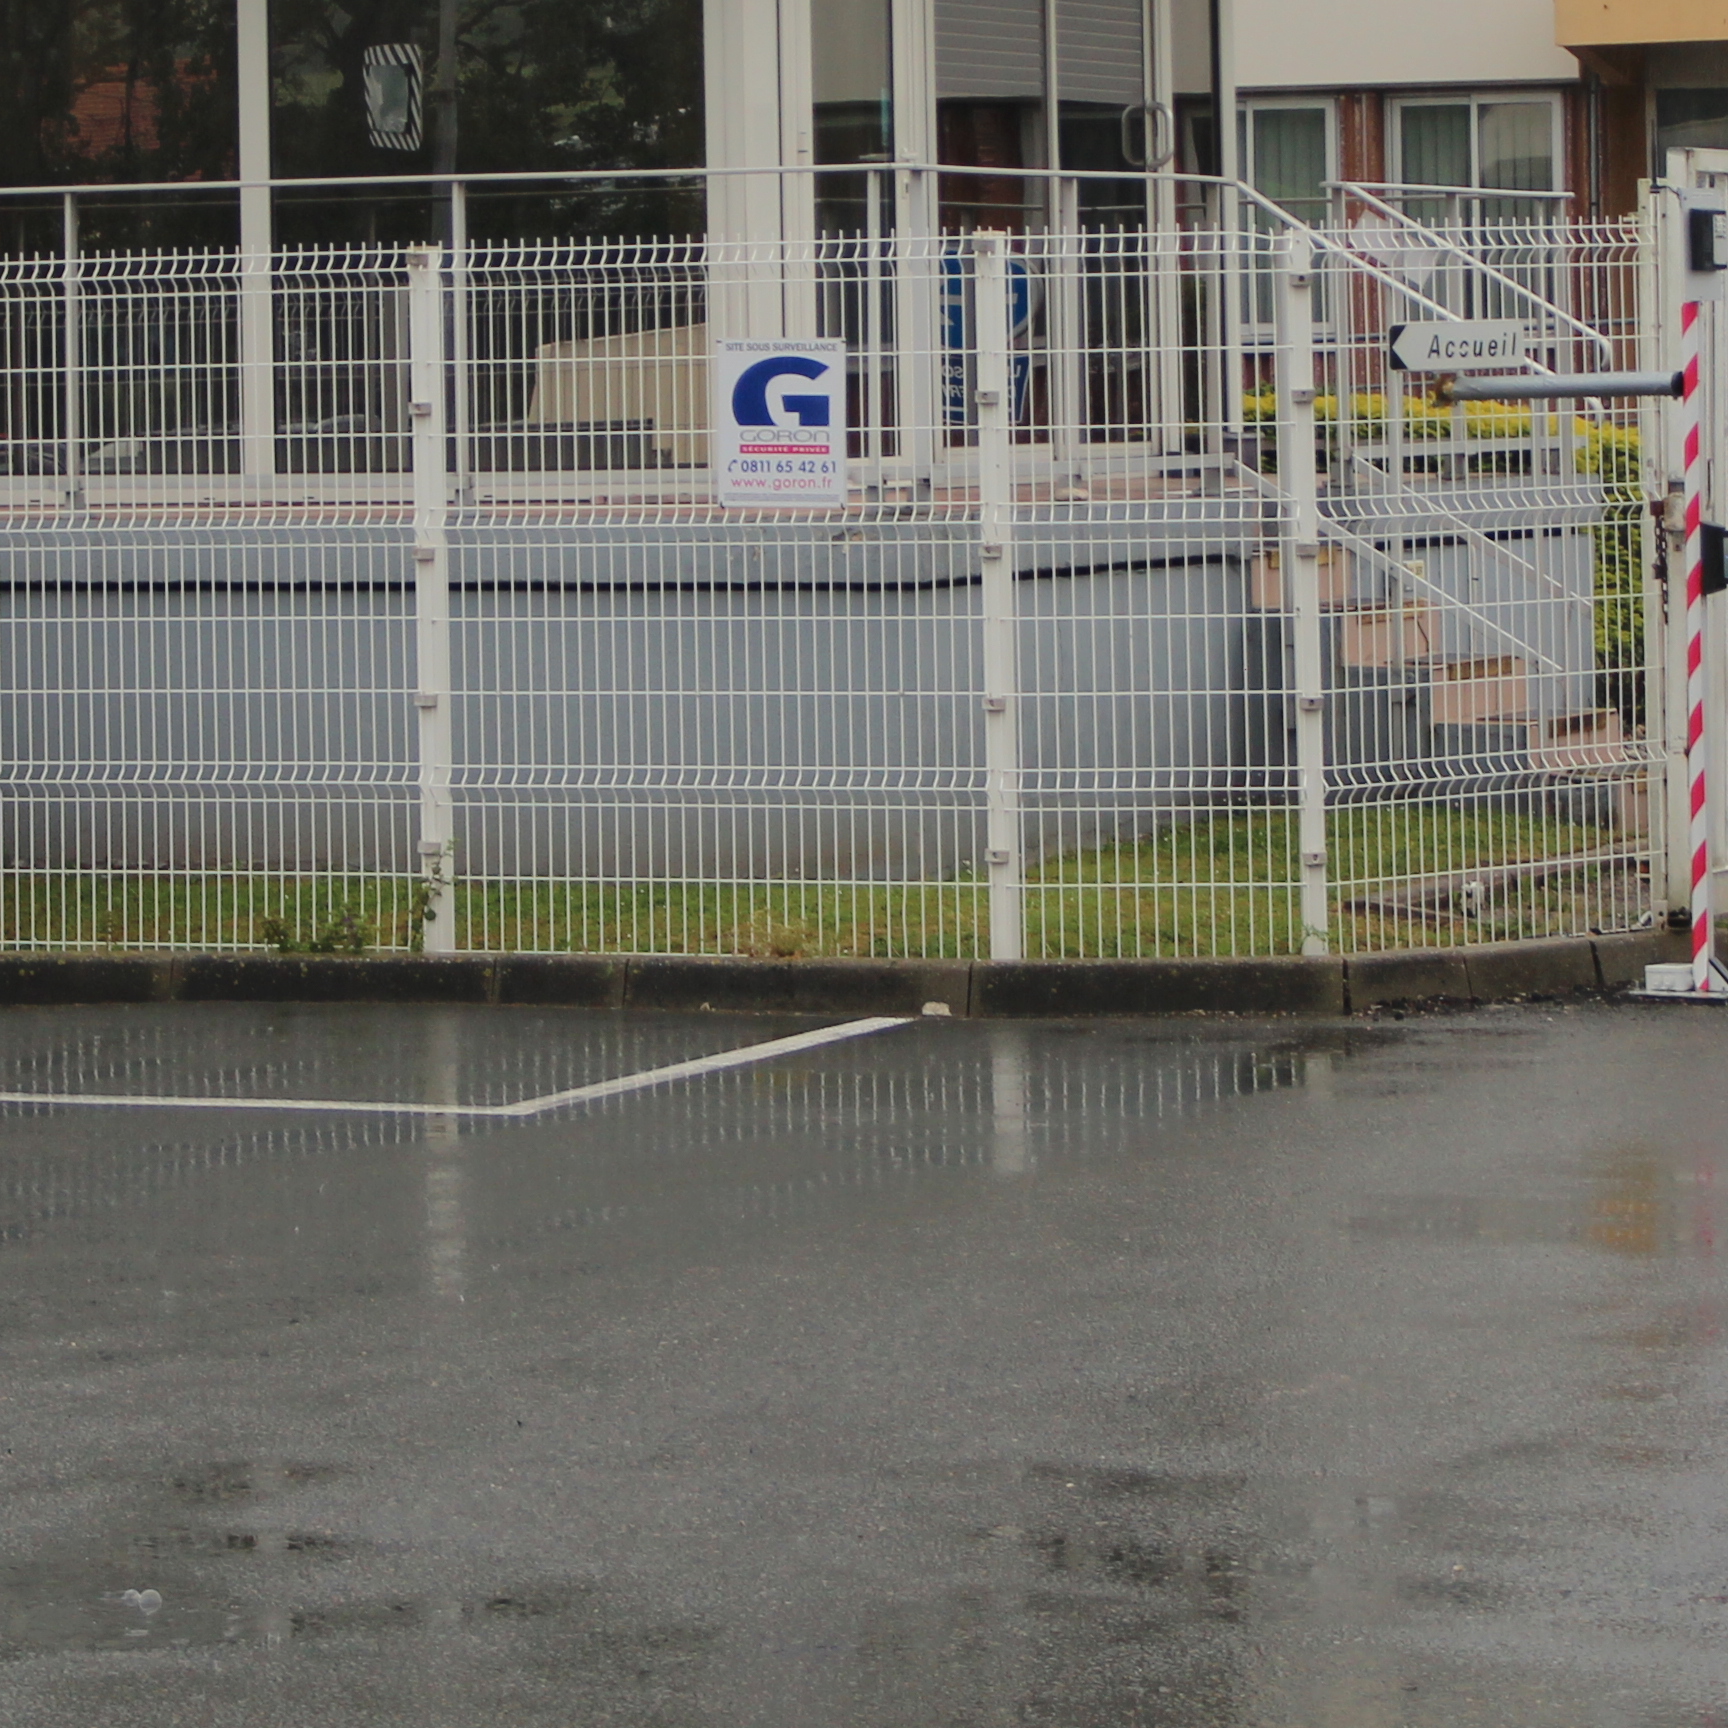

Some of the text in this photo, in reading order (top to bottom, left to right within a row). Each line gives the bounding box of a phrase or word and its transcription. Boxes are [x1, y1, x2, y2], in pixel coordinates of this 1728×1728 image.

[725, 342, 838, 351] SITE SOUS SURVEILLANCE
[1427, 332, 1517, 359] Accueil
[732, 356, 830, 426] G
[741, 460, 836, 473] 0811 65 42 61
[731, 476, 833, 491] www.goron.fr
